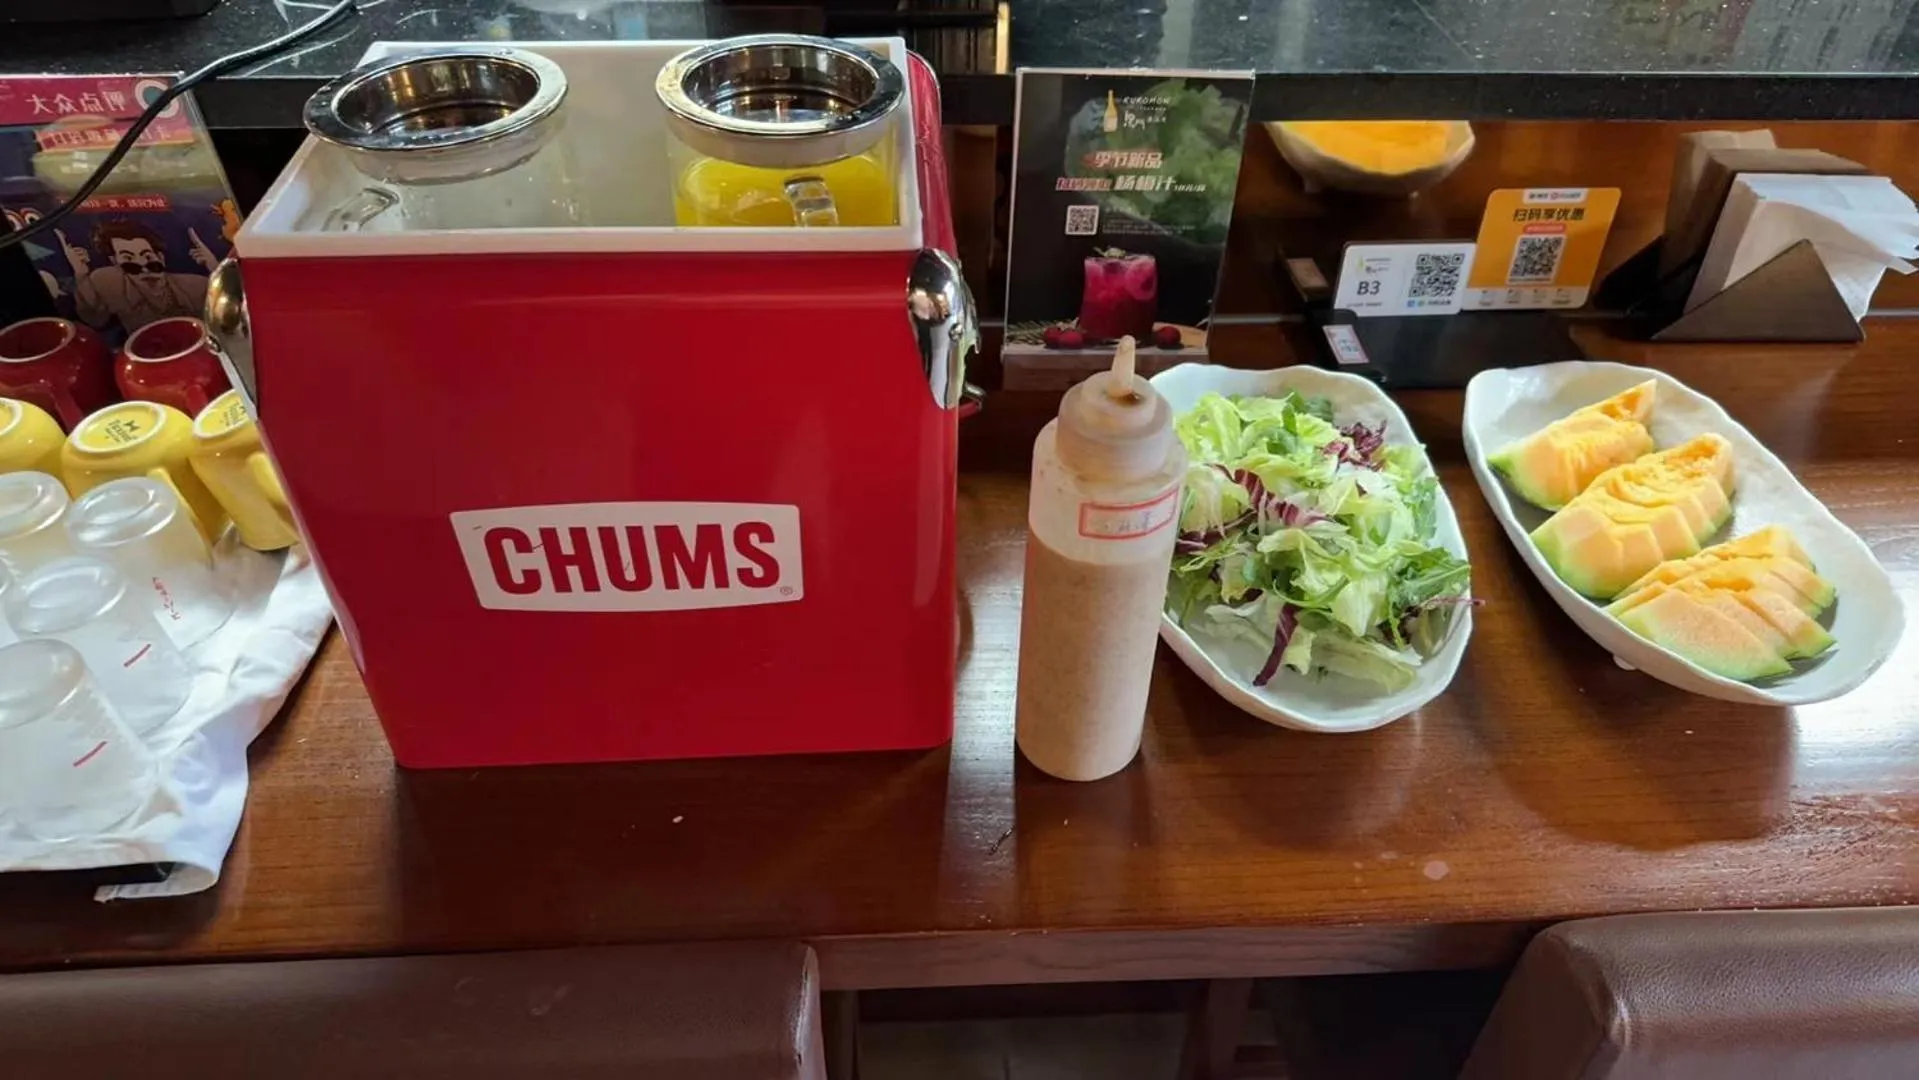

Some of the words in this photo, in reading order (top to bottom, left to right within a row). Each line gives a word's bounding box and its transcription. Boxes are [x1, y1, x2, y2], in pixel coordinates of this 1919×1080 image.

[25, 91, 126, 114] 大众点评
[1094, 151, 1163, 169] 季节新品
[1115, 175, 1175, 191] 杨梅汁
[1513, 208, 1585, 222] 扫码享优惠
[1357, 280, 1381, 295] B3
[484, 521, 780, 596] CHUMS
